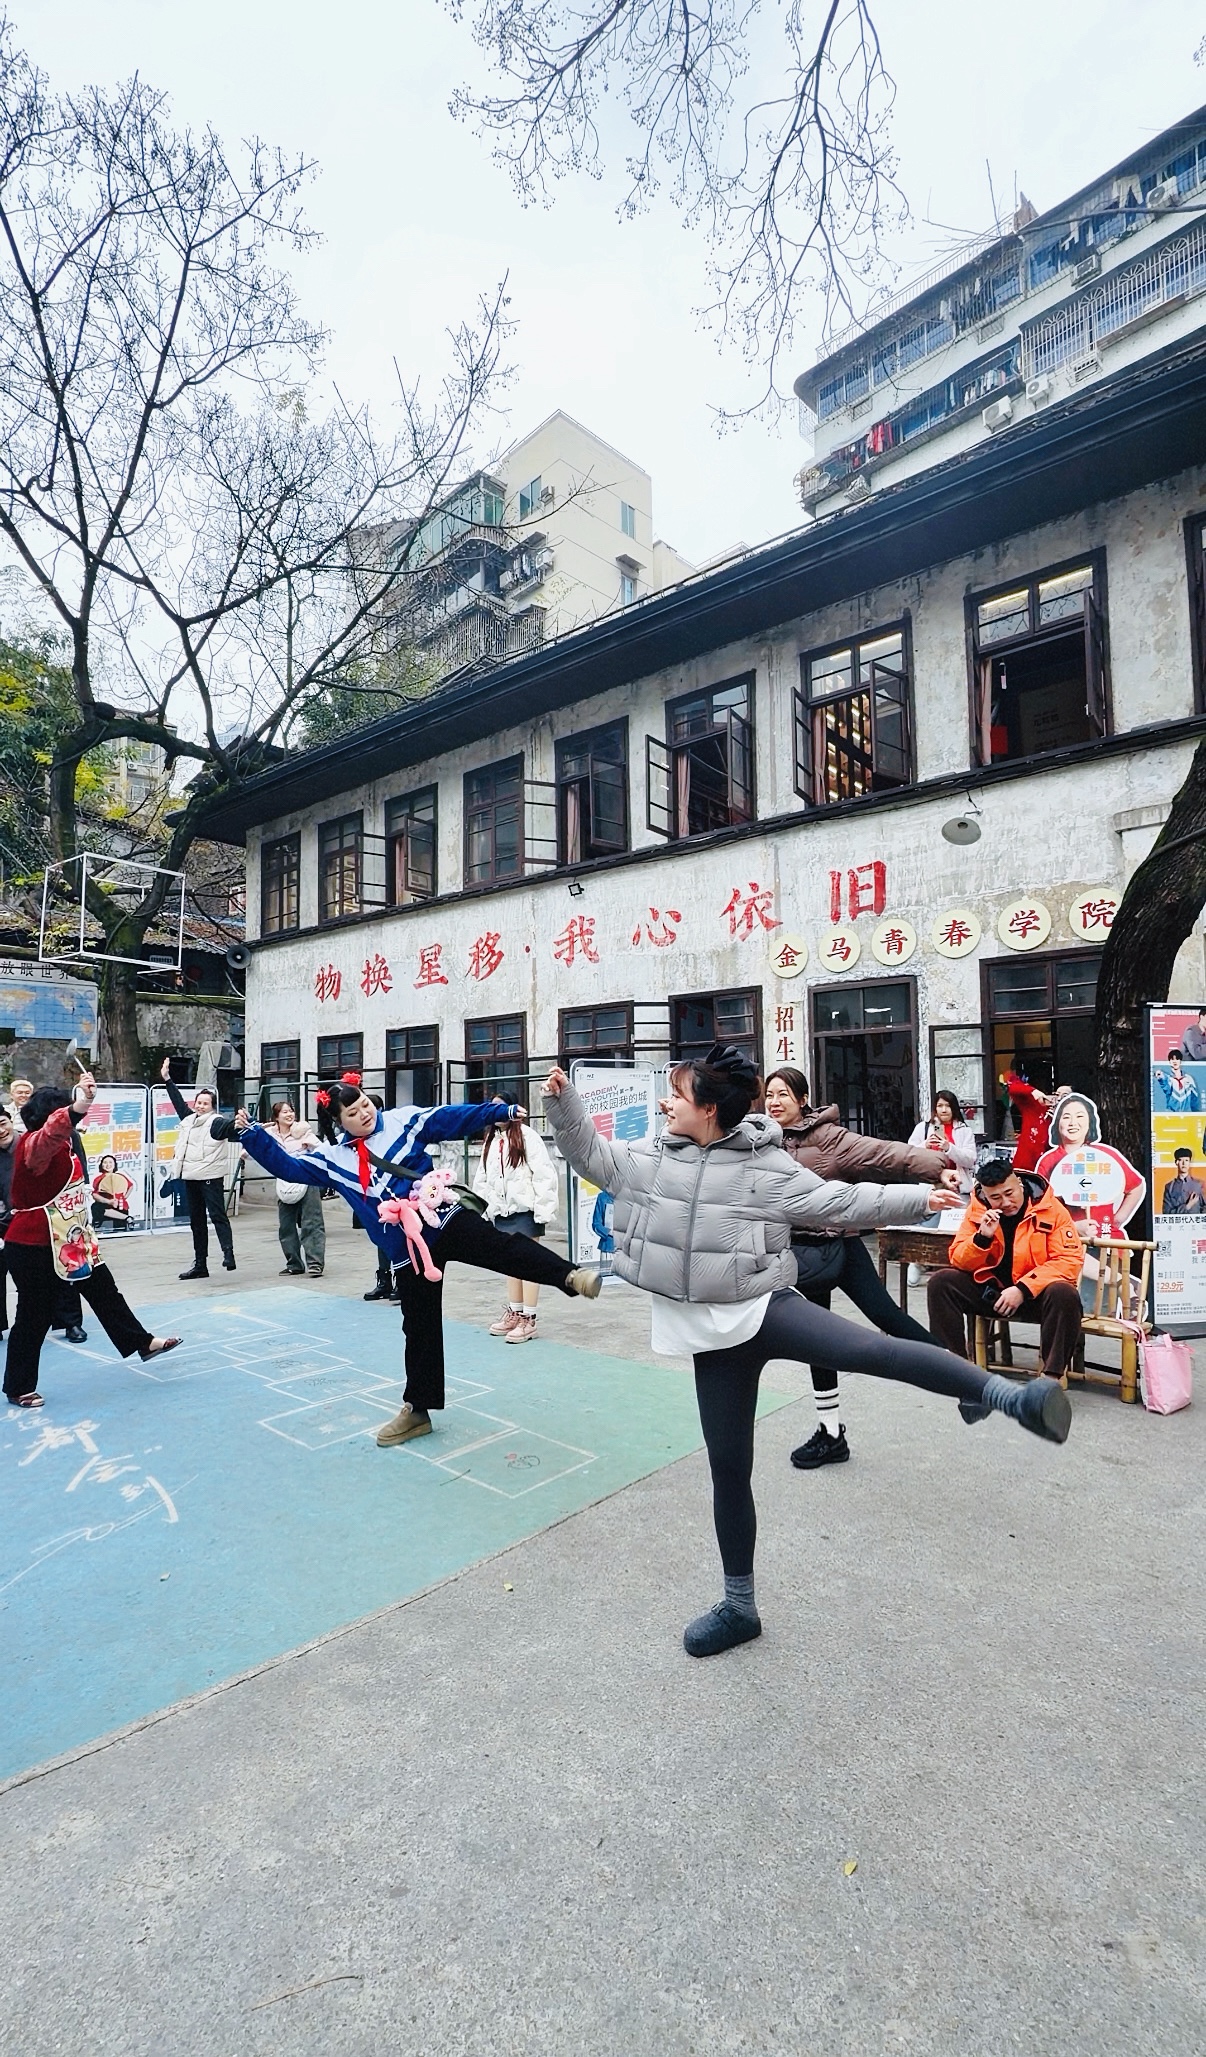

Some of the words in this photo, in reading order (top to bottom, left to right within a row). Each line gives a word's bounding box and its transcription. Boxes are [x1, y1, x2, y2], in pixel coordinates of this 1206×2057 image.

[774, 899, 1117, 968] 金马青春学院
[775, 1006, 796, 1061] 招生
[591, 1091, 618, 1103] YOUTH
[1062, 1163, 1111, 1175] 青春学院
